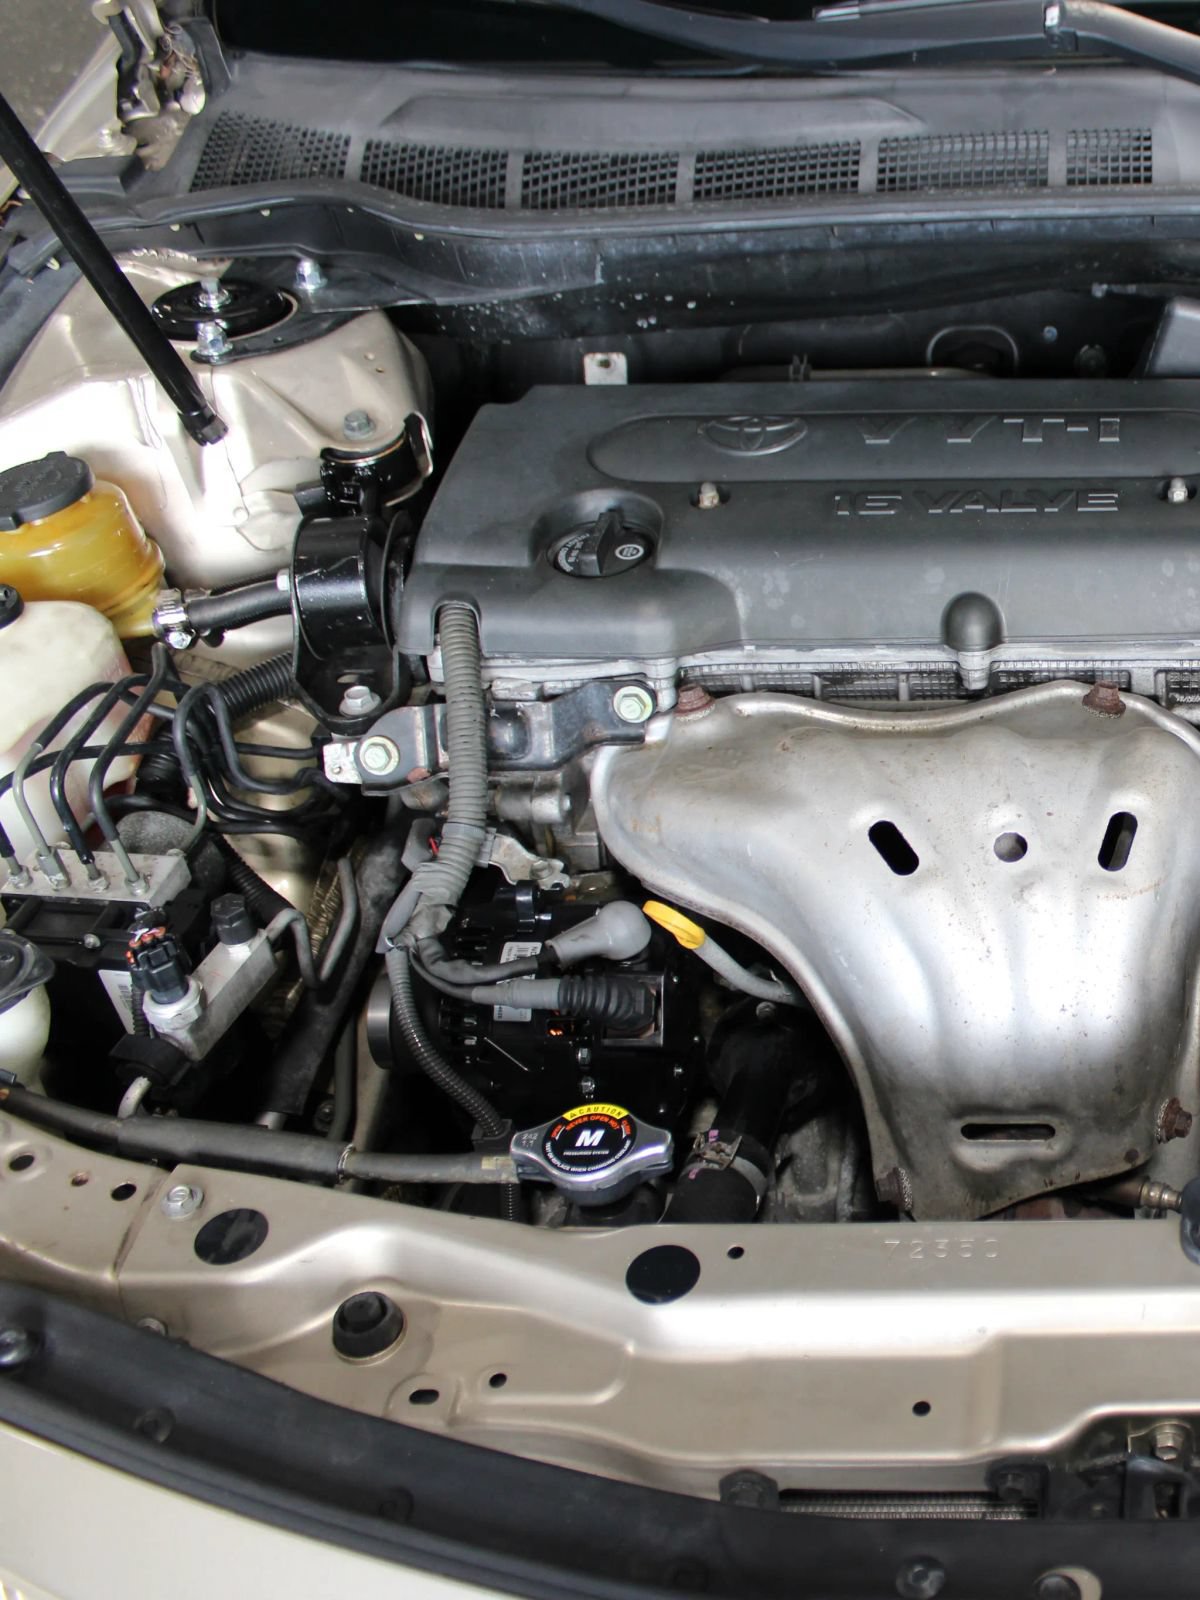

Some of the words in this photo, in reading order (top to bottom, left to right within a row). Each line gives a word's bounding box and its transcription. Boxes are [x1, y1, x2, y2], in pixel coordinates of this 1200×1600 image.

[834, 491, 903, 516] 16
[914, 489, 1119, 514] VALVE
[578, 1106, 623, 1118] CAUTION
[565, 1116, 588, 1131] NEVER
[575, 1129, 606, 1147] M
[884, 1239, 999, 1259] 72350
